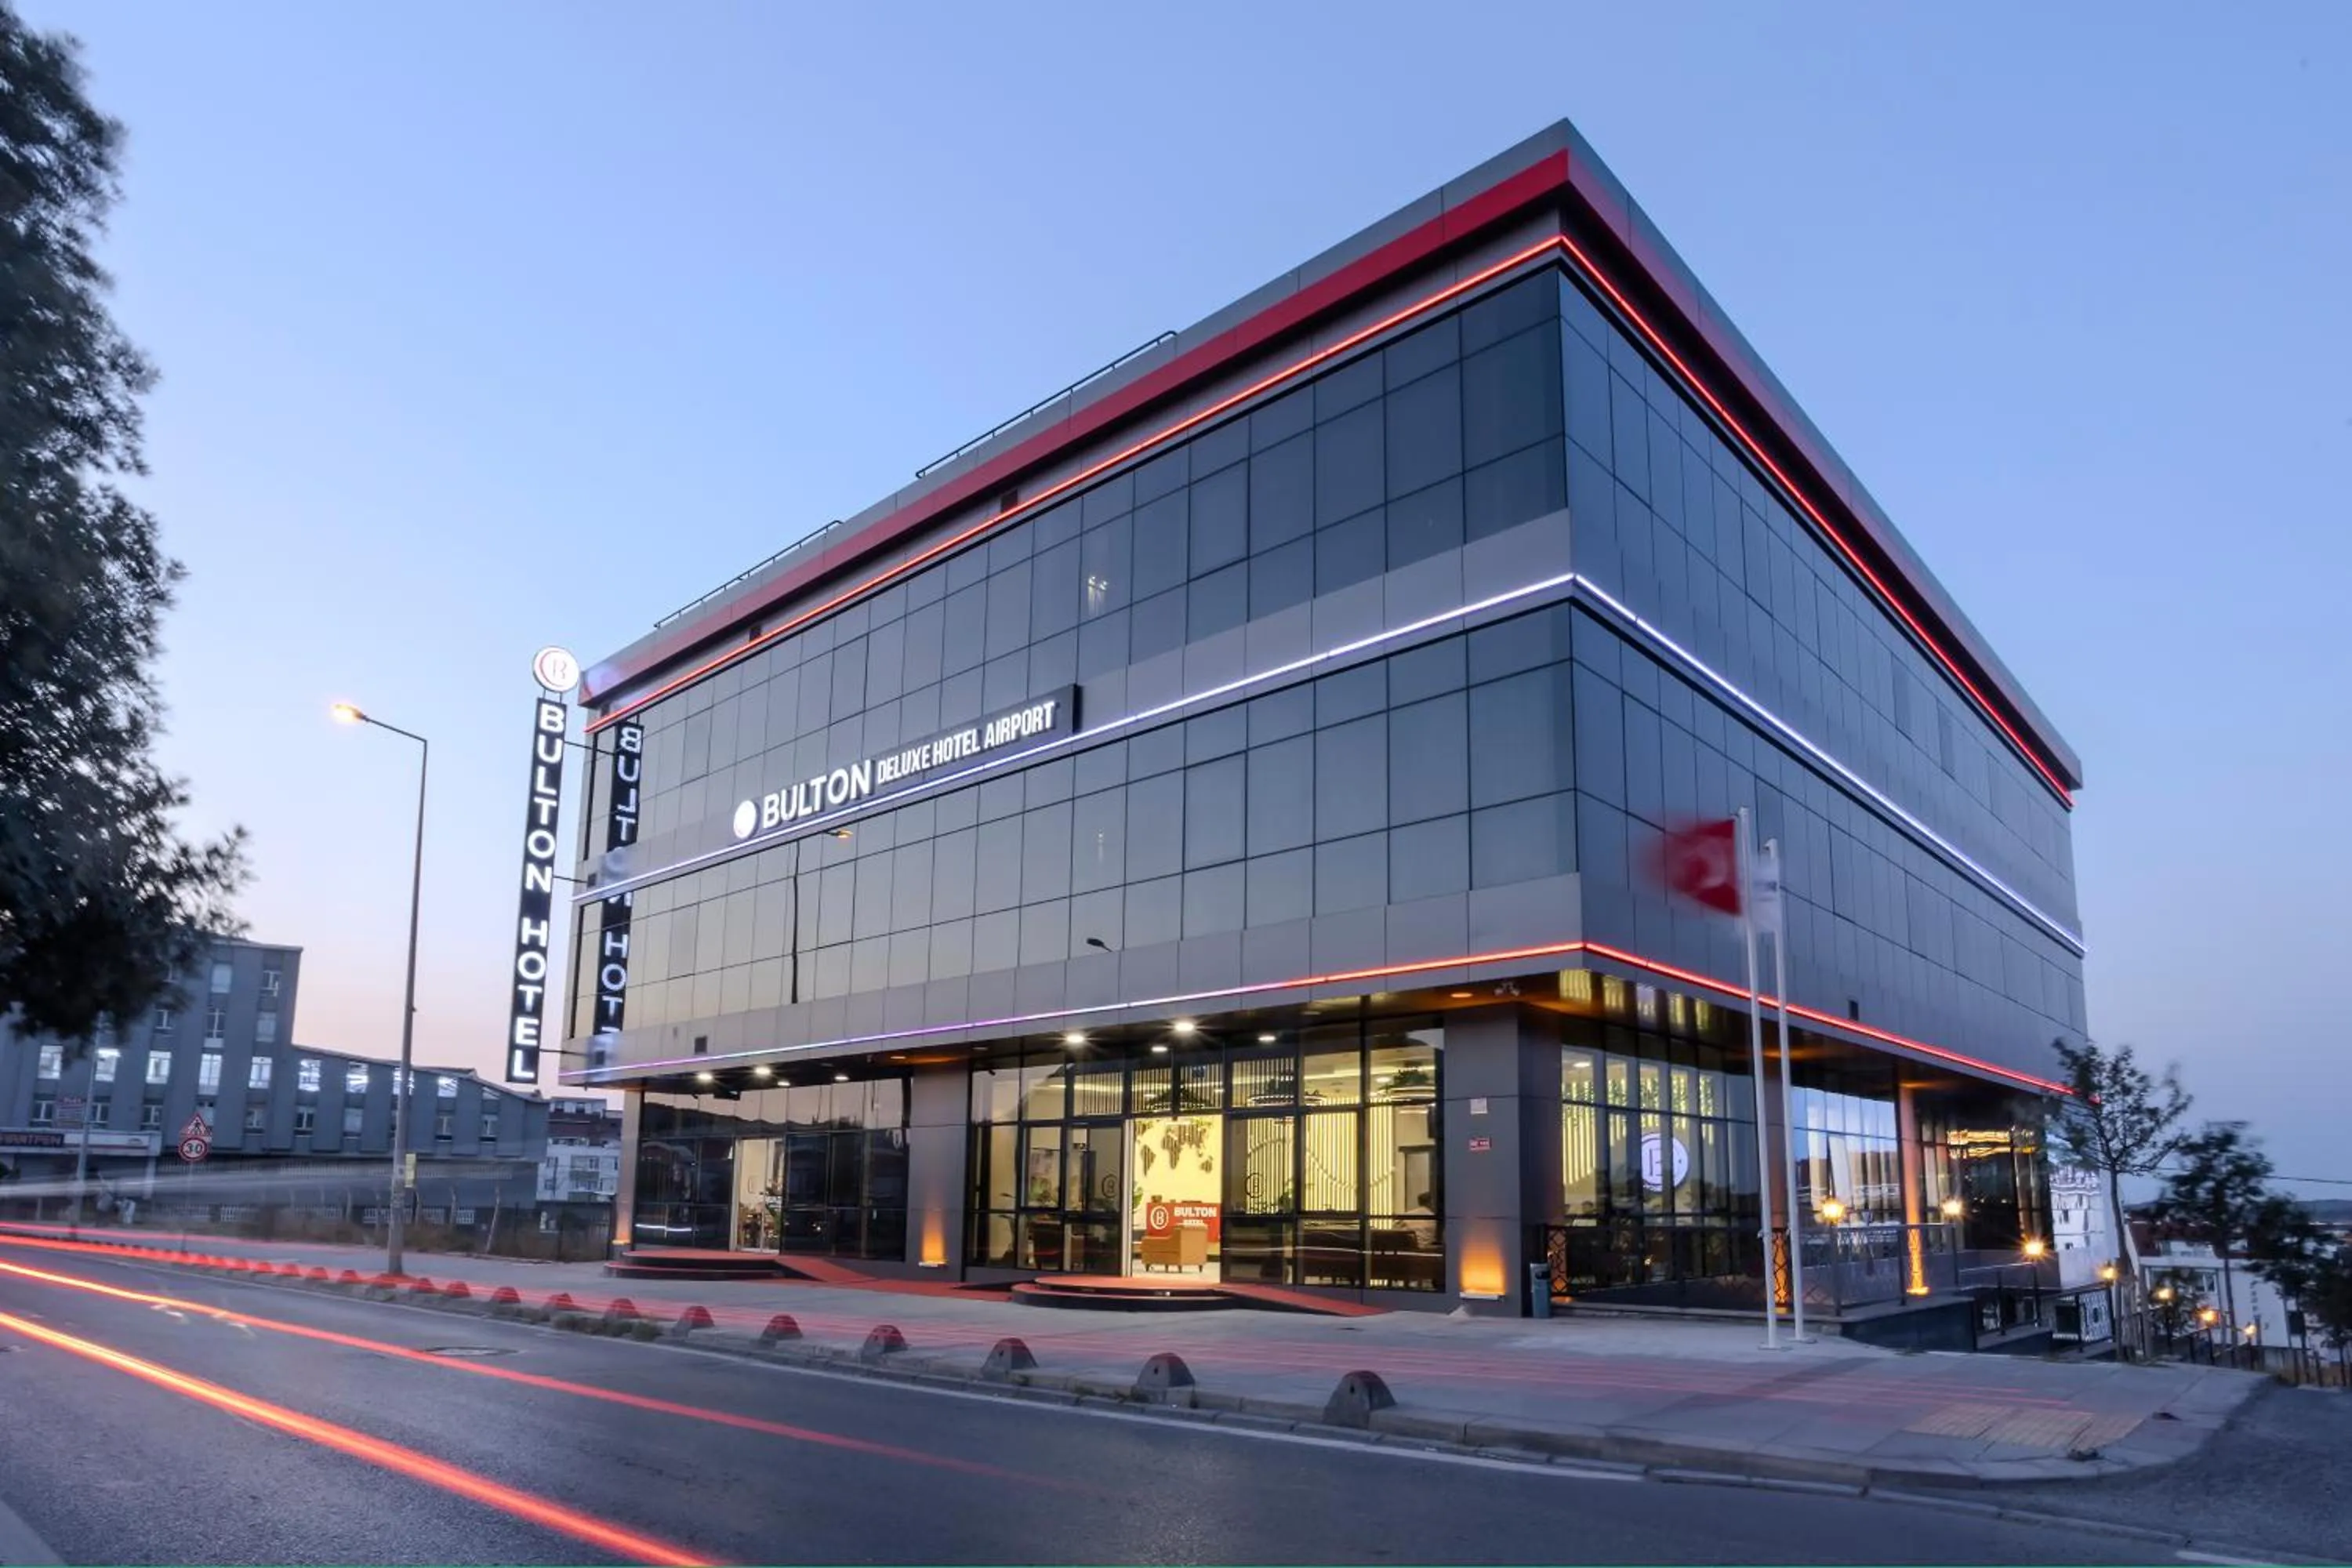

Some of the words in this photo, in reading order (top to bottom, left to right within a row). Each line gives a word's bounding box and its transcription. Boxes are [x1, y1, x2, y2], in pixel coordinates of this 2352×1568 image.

[524, 705, 564, 894] BULTON
[763, 760, 871, 829] BULTON
[877, 742, 931, 784] DELUXE
[932, 724, 981, 765] HOTEL
[984, 701, 1055, 750] AIRPORT
[512, 917, 547, 1080] HOTEL
[184, 1142, 203, 1154] 30
[1174, 1207, 1217, 1217] BULTON
